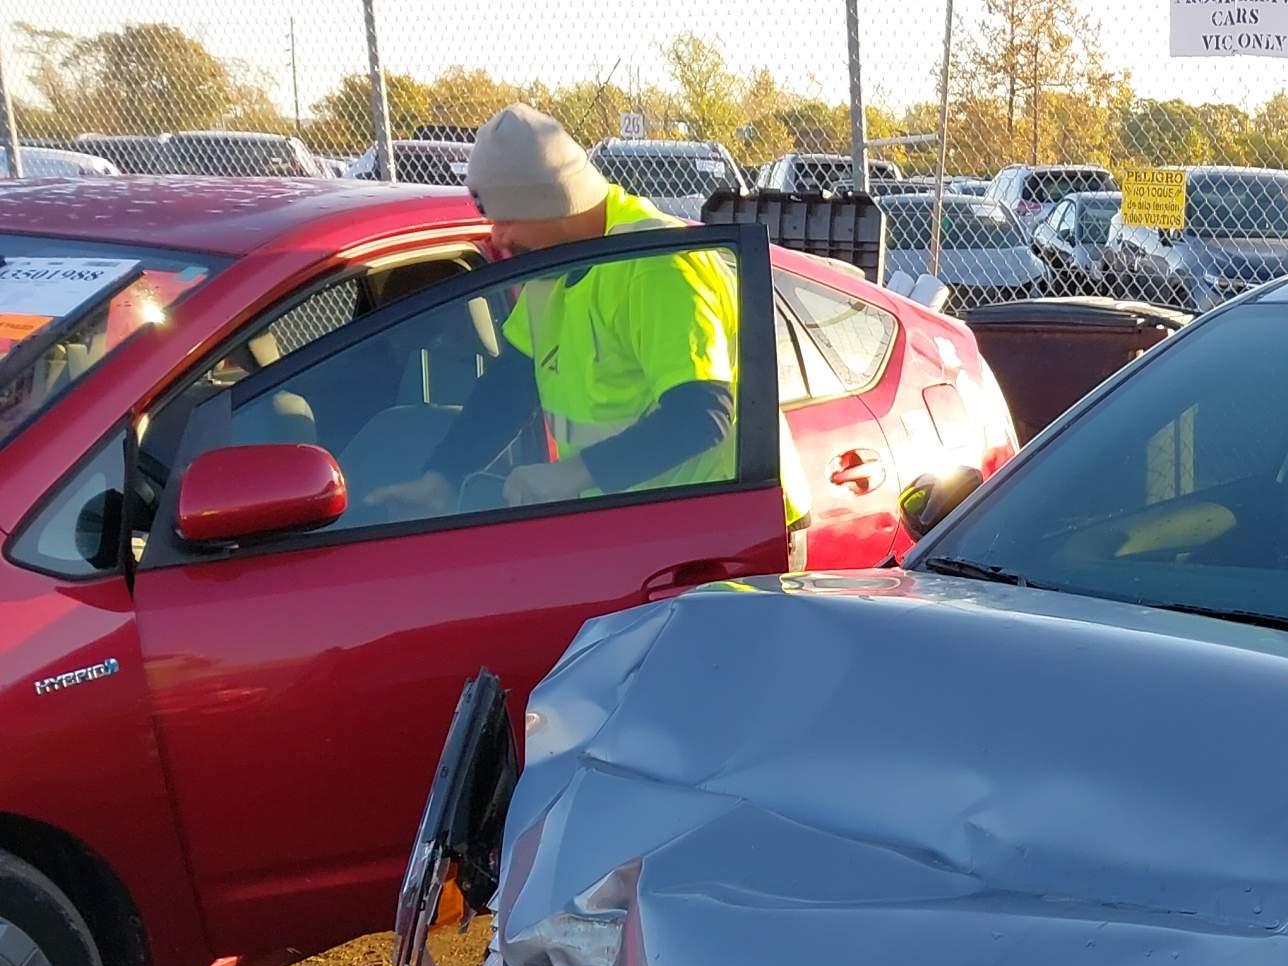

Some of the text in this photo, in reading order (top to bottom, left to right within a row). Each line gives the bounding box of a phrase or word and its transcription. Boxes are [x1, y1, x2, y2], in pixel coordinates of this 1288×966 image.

[1212, 8, 1259, 26] CARS
[1202, 33, 1287, 51] VIC ONLY
[1126, 171, 1184, 184] PELIGRO
[1133, 187, 1145, 197] NO
